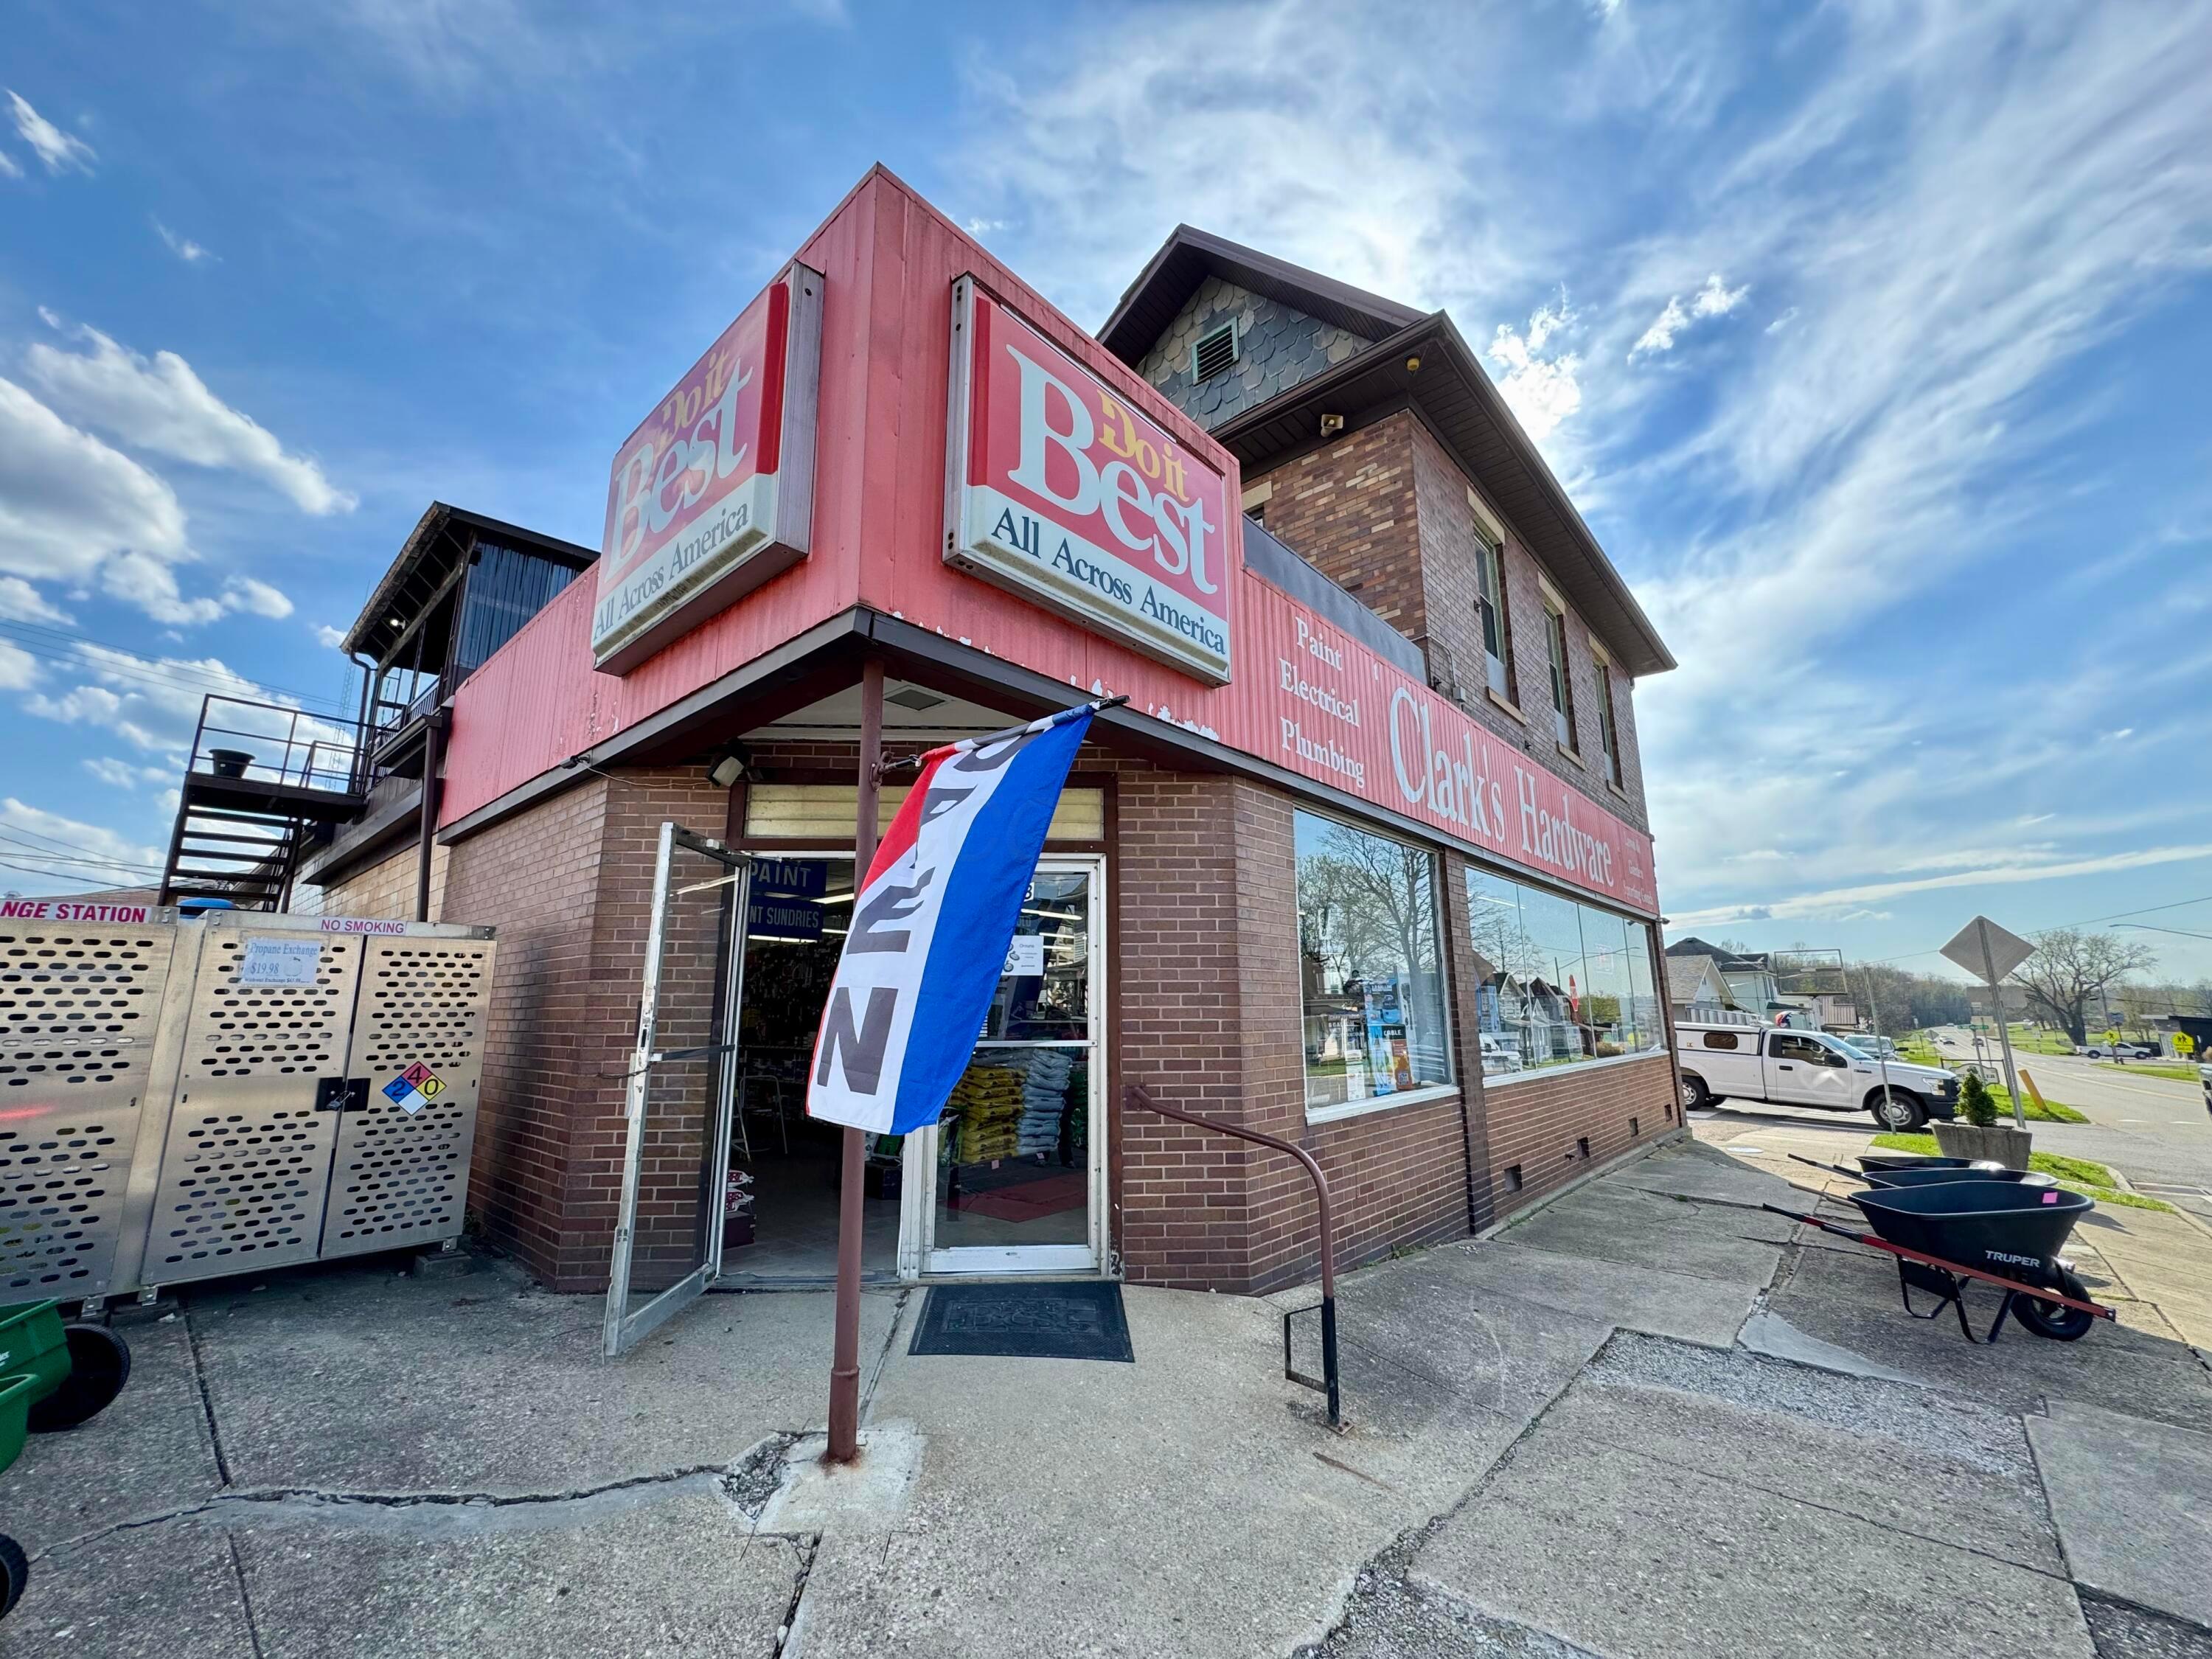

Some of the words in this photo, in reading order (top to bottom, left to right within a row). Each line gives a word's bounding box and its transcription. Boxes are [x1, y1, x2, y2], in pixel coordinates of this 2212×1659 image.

[655, 386, 702, 454] Do
[701, 347, 730, 414] it
[605, 356, 754, 583] Best
[1006, 344, 1218, 595] Best
[1097, 389, 1161, 479] Do
[1164, 445, 1189, 502] it
[592, 606, 613, 641] All
[617, 567, 664, 619] Across
[668, 503, 748, 578] America
[991, 507, 1041, 560] All
[1051, 538, 1133, 605] Across
[1139, 585, 1225, 656] America
[1295, 616, 1343, 672] Paint
[1279, 658, 1360, 728] Electrical
[1280, 716, 1365, 789] Plumbing
[1390, 686, 1505, 844] Clark's
[1513, 765, 1615, 888] Hardware
[55, 903, 147, 923] STATION
[321, 919, 341, 931] NO
[344, 920, 404, 933] SMOKING
[767, 908, 819, 928] SUNDRIES
[251, 943, 281, 956] Propane
[282, 944, 318, 957] Exchange
[251, 962, 279, 975] $19.98
[392, 1080, 406, 1096] 2
[424, 1078, 439, 1096] 0
[407, 1065, 422, 1084] 4
[1985, 1250, 2040, 1267] TRUPER
